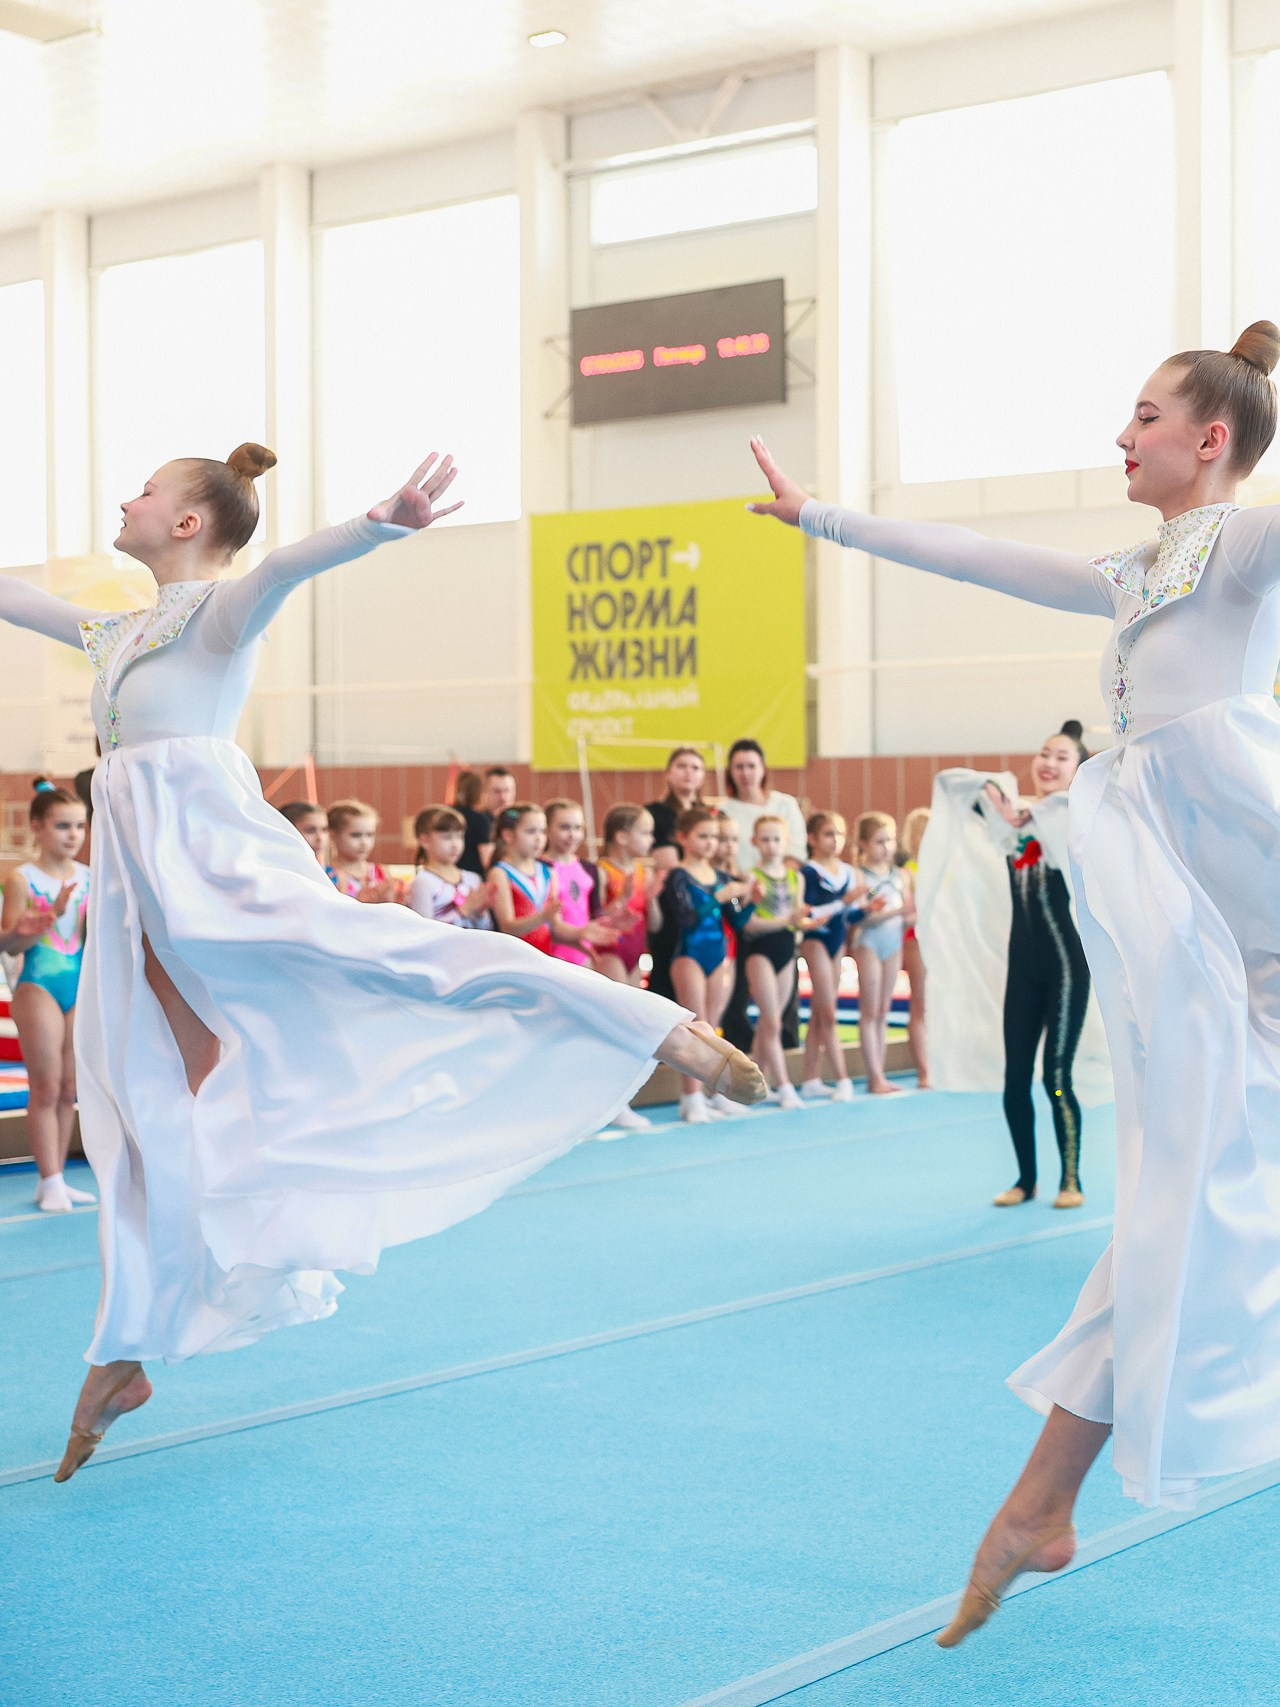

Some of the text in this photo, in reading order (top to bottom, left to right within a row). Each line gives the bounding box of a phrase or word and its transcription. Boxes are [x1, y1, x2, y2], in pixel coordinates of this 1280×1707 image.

[567, 537, 672, 583] СПОРТ
[567, 585, 697, 632] НОРМА
[569, 635, 697, 681] ЖИЗНИ
